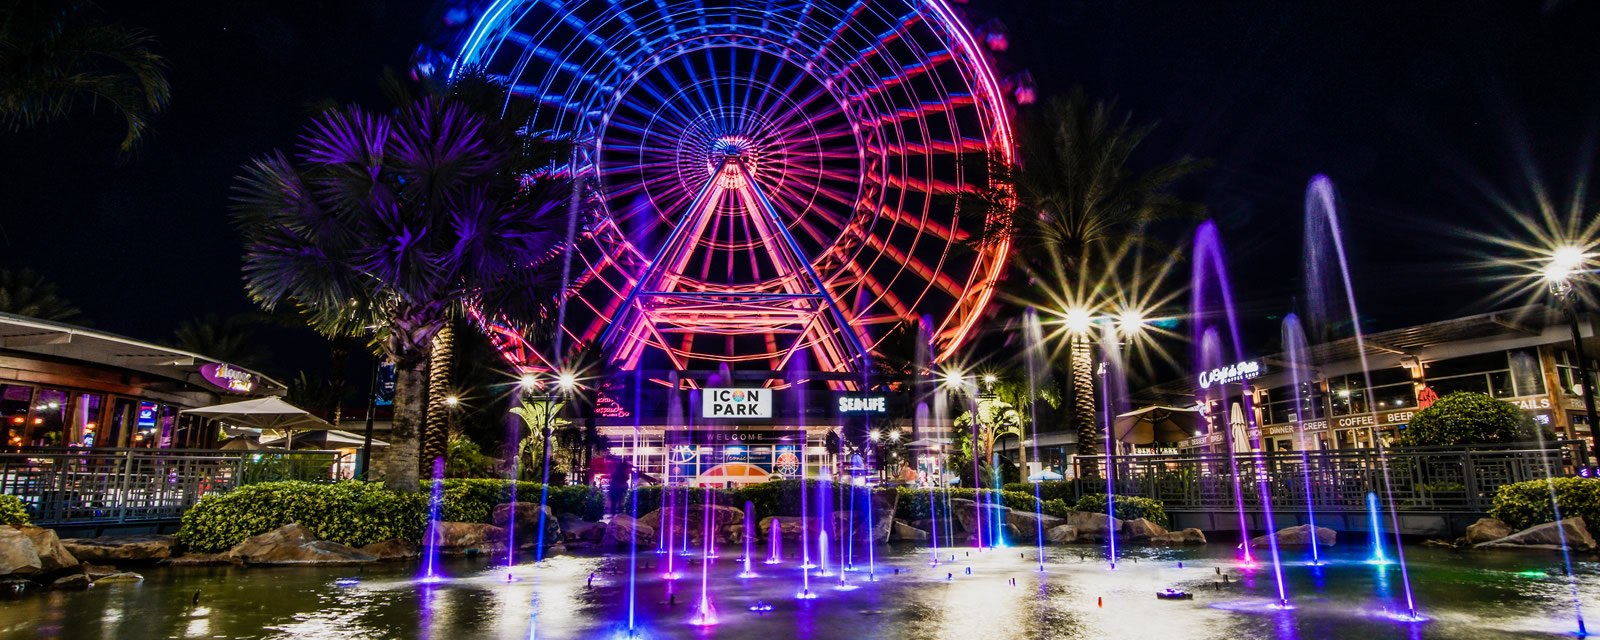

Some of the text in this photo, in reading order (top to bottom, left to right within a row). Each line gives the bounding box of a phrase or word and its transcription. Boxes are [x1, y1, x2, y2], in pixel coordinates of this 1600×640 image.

[713, 390, 759, 403] ICON
[713, 403, 759, 416] PARK
[1508, 398, 1550, 410] TAILS
[1247, 411, 1414, 438] UNCH DINNER CREPE COFFEE BEER
[706, 433, 763, 441] WELCOME
[1210, 434, 1224, 443] BREA
